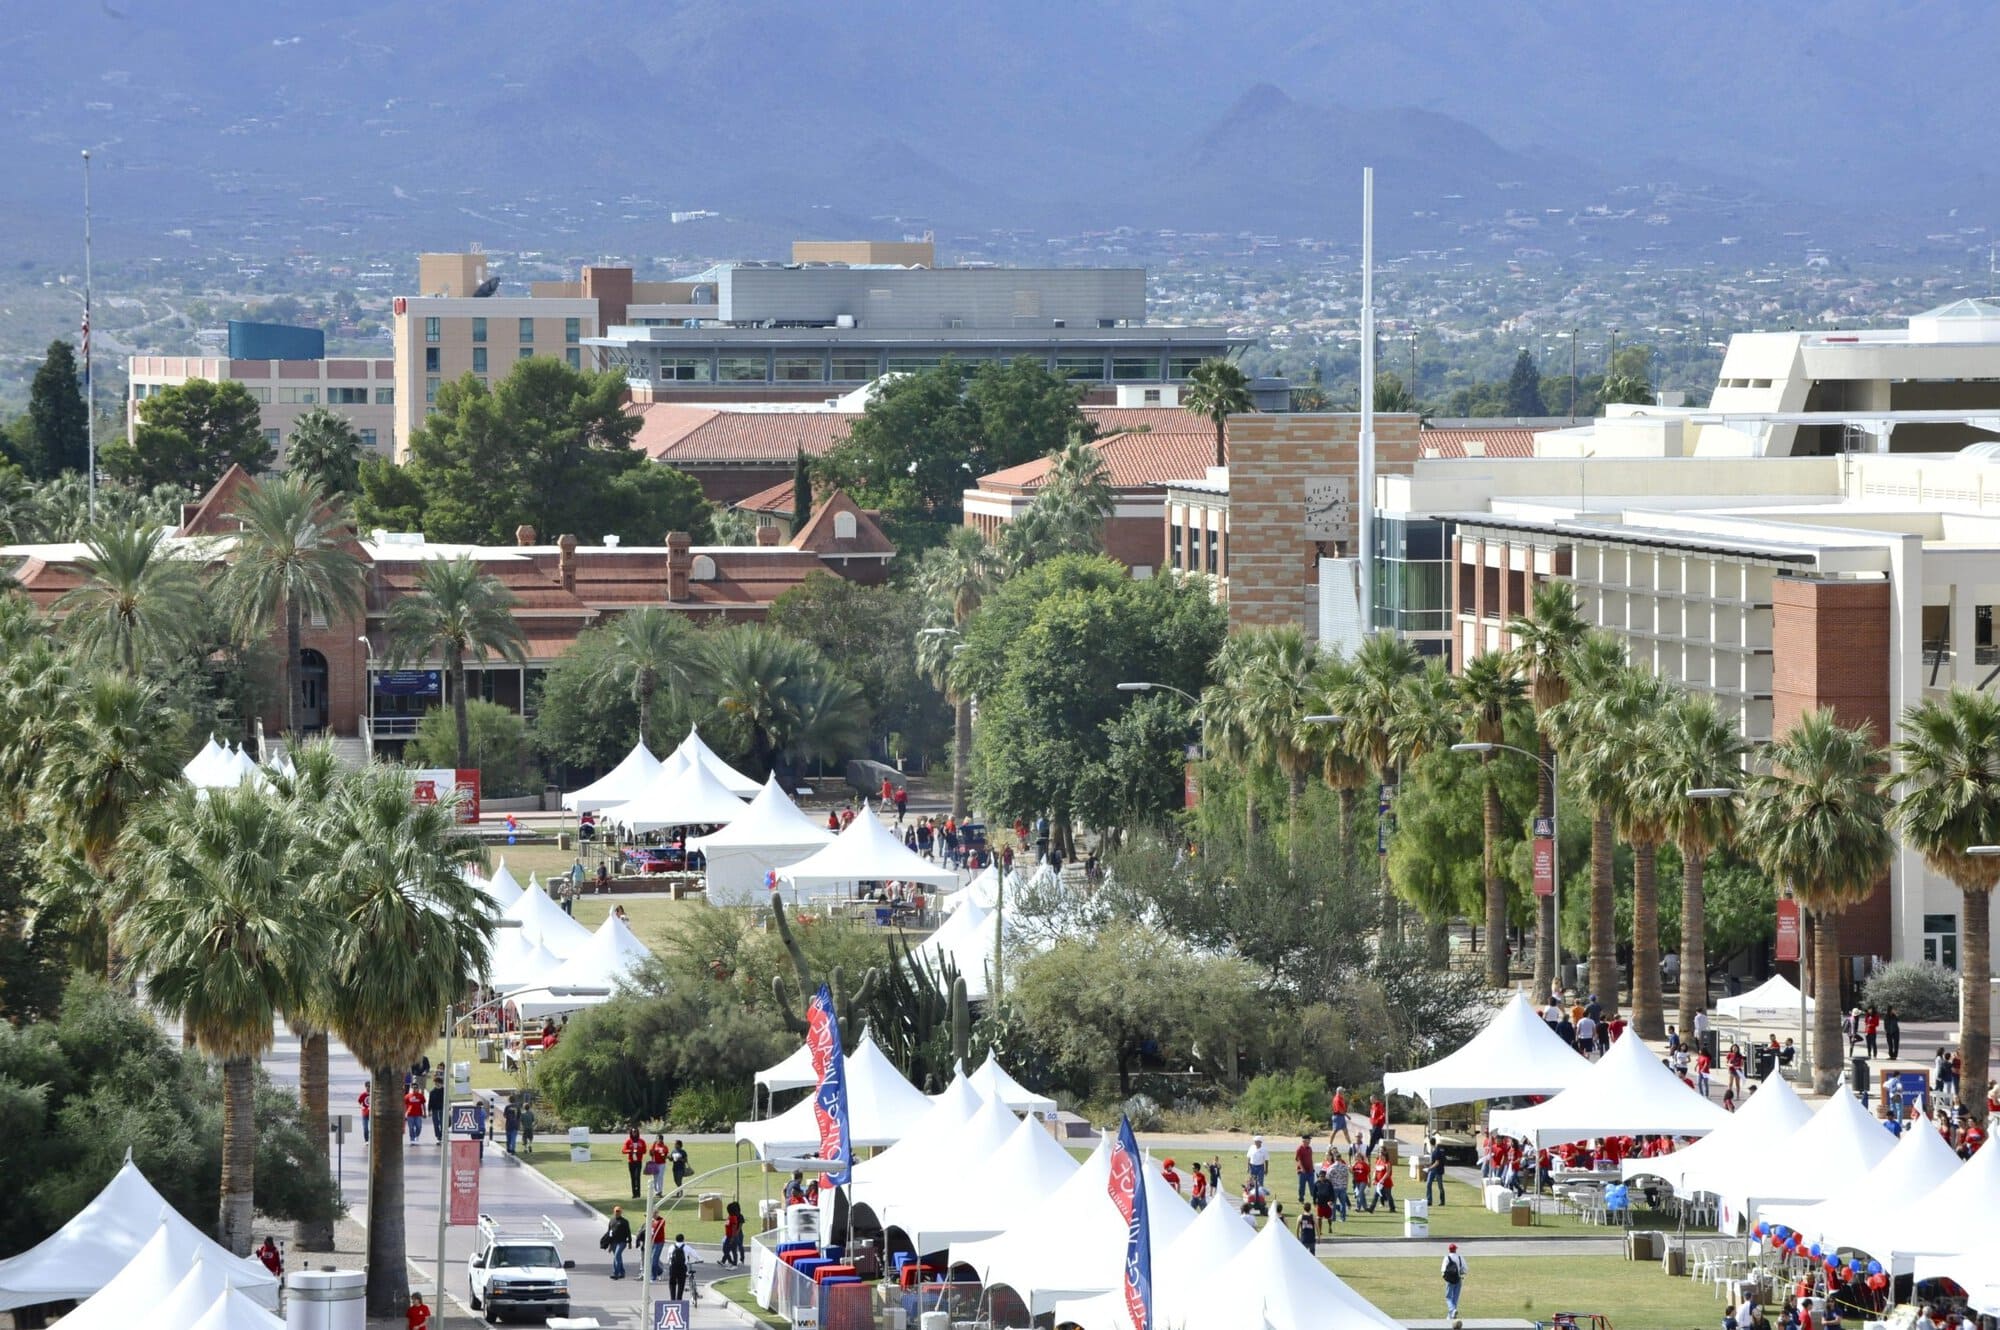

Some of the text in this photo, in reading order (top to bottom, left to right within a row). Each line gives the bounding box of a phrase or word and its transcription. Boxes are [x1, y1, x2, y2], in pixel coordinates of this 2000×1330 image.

[1535, 819, 1551, 835] A
[453, 1108, 479, 1132] A
[657, 1303, 687, 1330] A
